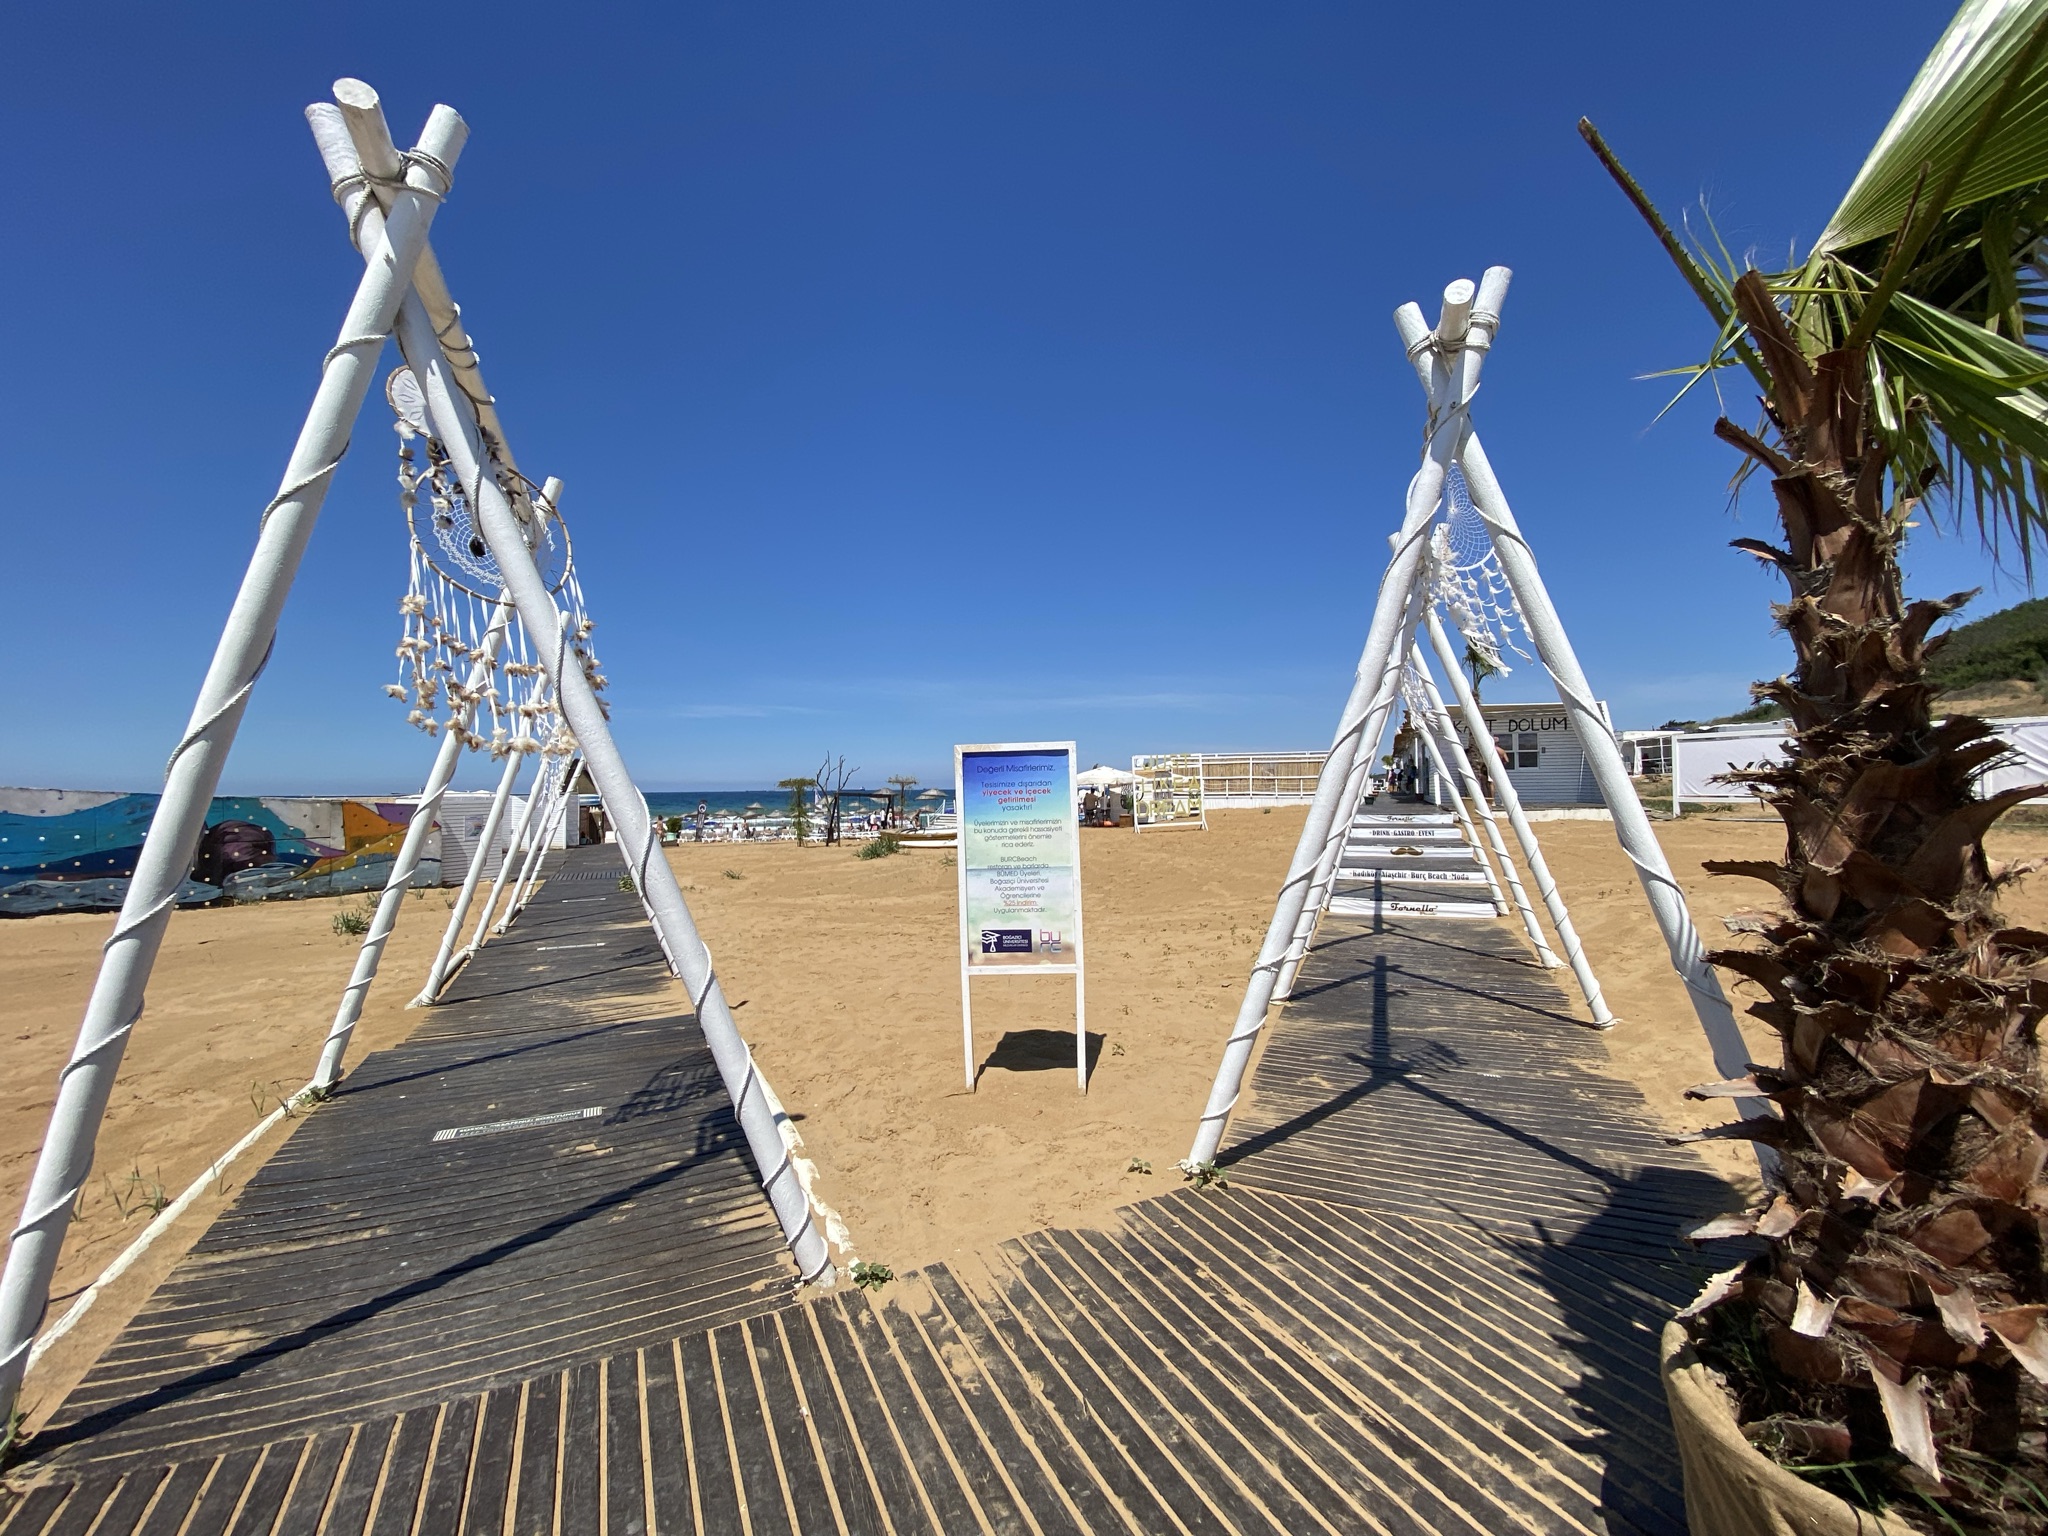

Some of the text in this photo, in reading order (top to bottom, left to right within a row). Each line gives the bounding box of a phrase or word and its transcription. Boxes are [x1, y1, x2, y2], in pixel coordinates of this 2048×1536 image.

[1508, 717, 1568, 733] DOLUM
[976, 765, 1005, 774] Değerli
[1017, 780, 1052, 788] dışarıdan
[982, 788, 1012, 796] yiyecek
[998, 796, 1037, 805] getirilmesi
[1137, 799, 1202, 818] DREAM
[974, 819, 1009, 827] Üyelerimizin
[1411, 872, 1427, 880] Burç
[1428, 872, 1448, 880] Beach
[1391, 902, 1436, 912] Fornello
